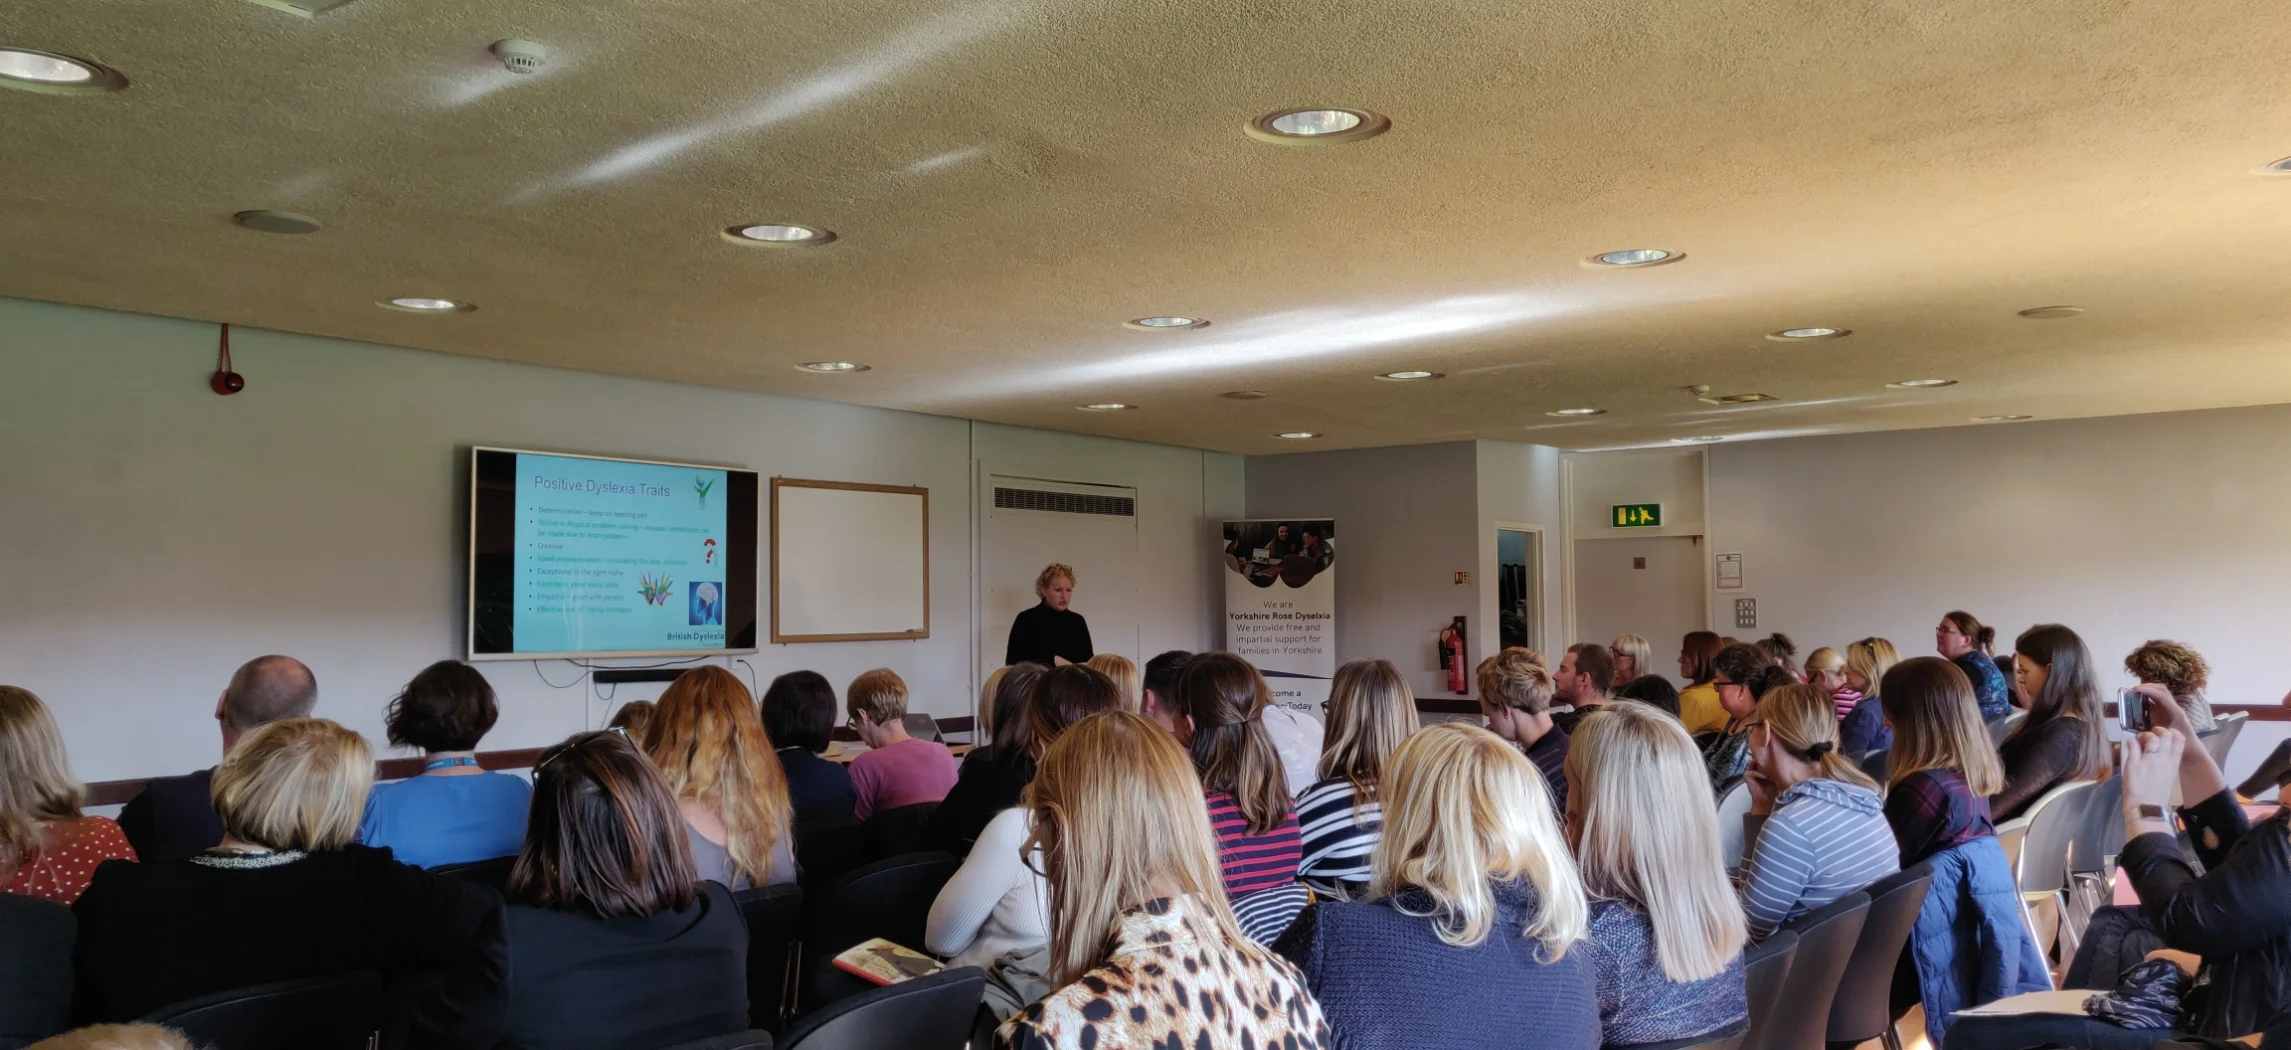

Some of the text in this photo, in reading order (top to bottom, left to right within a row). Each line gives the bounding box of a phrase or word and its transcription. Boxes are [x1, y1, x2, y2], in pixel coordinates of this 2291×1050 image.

[534, 476, 670, 497] Positive Dyslexia Traits
[538, 506, 583, 515] Determination
[589, 509, 603, 517] keep
[537, 542, 563, 550] Creative
[537, 567, 573, 576] Exceptional
[592, 569, 607, 578] right
[1263, 600, 1277, 608] We
[536, 605, 564, 613] Effective
[1229, 612, 1270, 620] Yorkshire
[1272, 612, 1293, 620] Rose
[1236, 624, 1250, 632] We
[1252, 624, 1284, 633] provide
[667, 632, 724, 642] British Dyslexia
[1236, 635, 1322, 644] impartial support for
[1238, 647, 1322, 655] families in Yorkshire
[1287, 701, 1313, 711] Today
